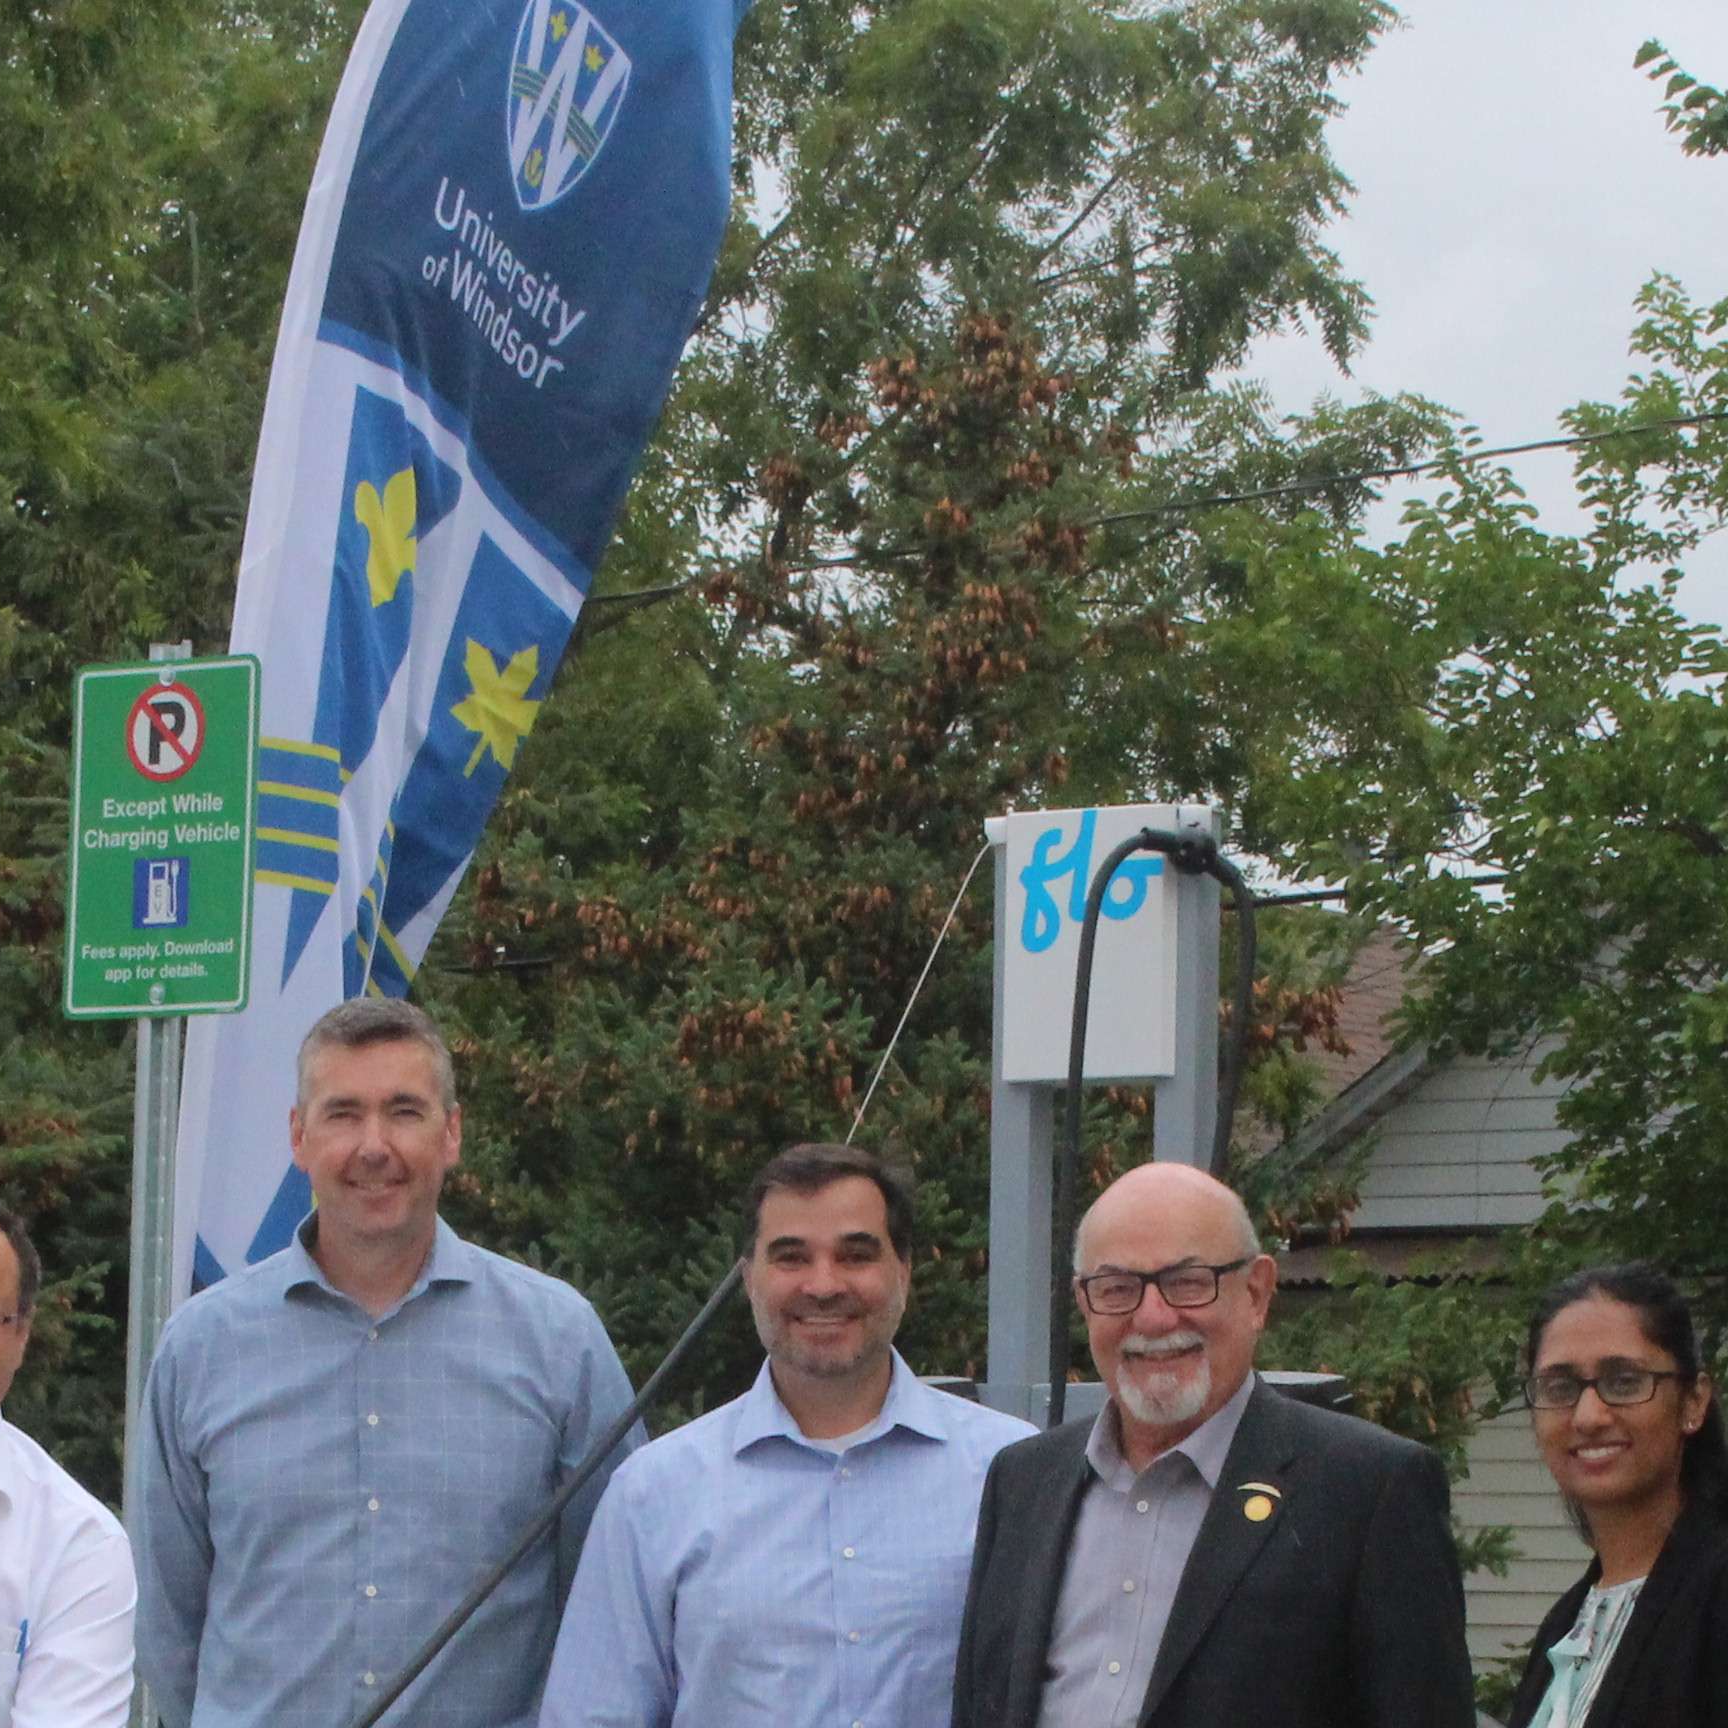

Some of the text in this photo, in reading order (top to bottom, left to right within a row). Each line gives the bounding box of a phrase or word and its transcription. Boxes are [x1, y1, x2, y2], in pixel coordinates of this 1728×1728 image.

[434, 176, 586, 347] University
[422, 248, 564, 389] of Windsor
[102, 793, 224, 819] Except While
[83, 822, 240, 851] Charging Vehicle
[1019, 810, 1164, 952] flo
[80, 938, 234, 962] Fees apply. Download
[104, 961, 209, 984] app for details.
